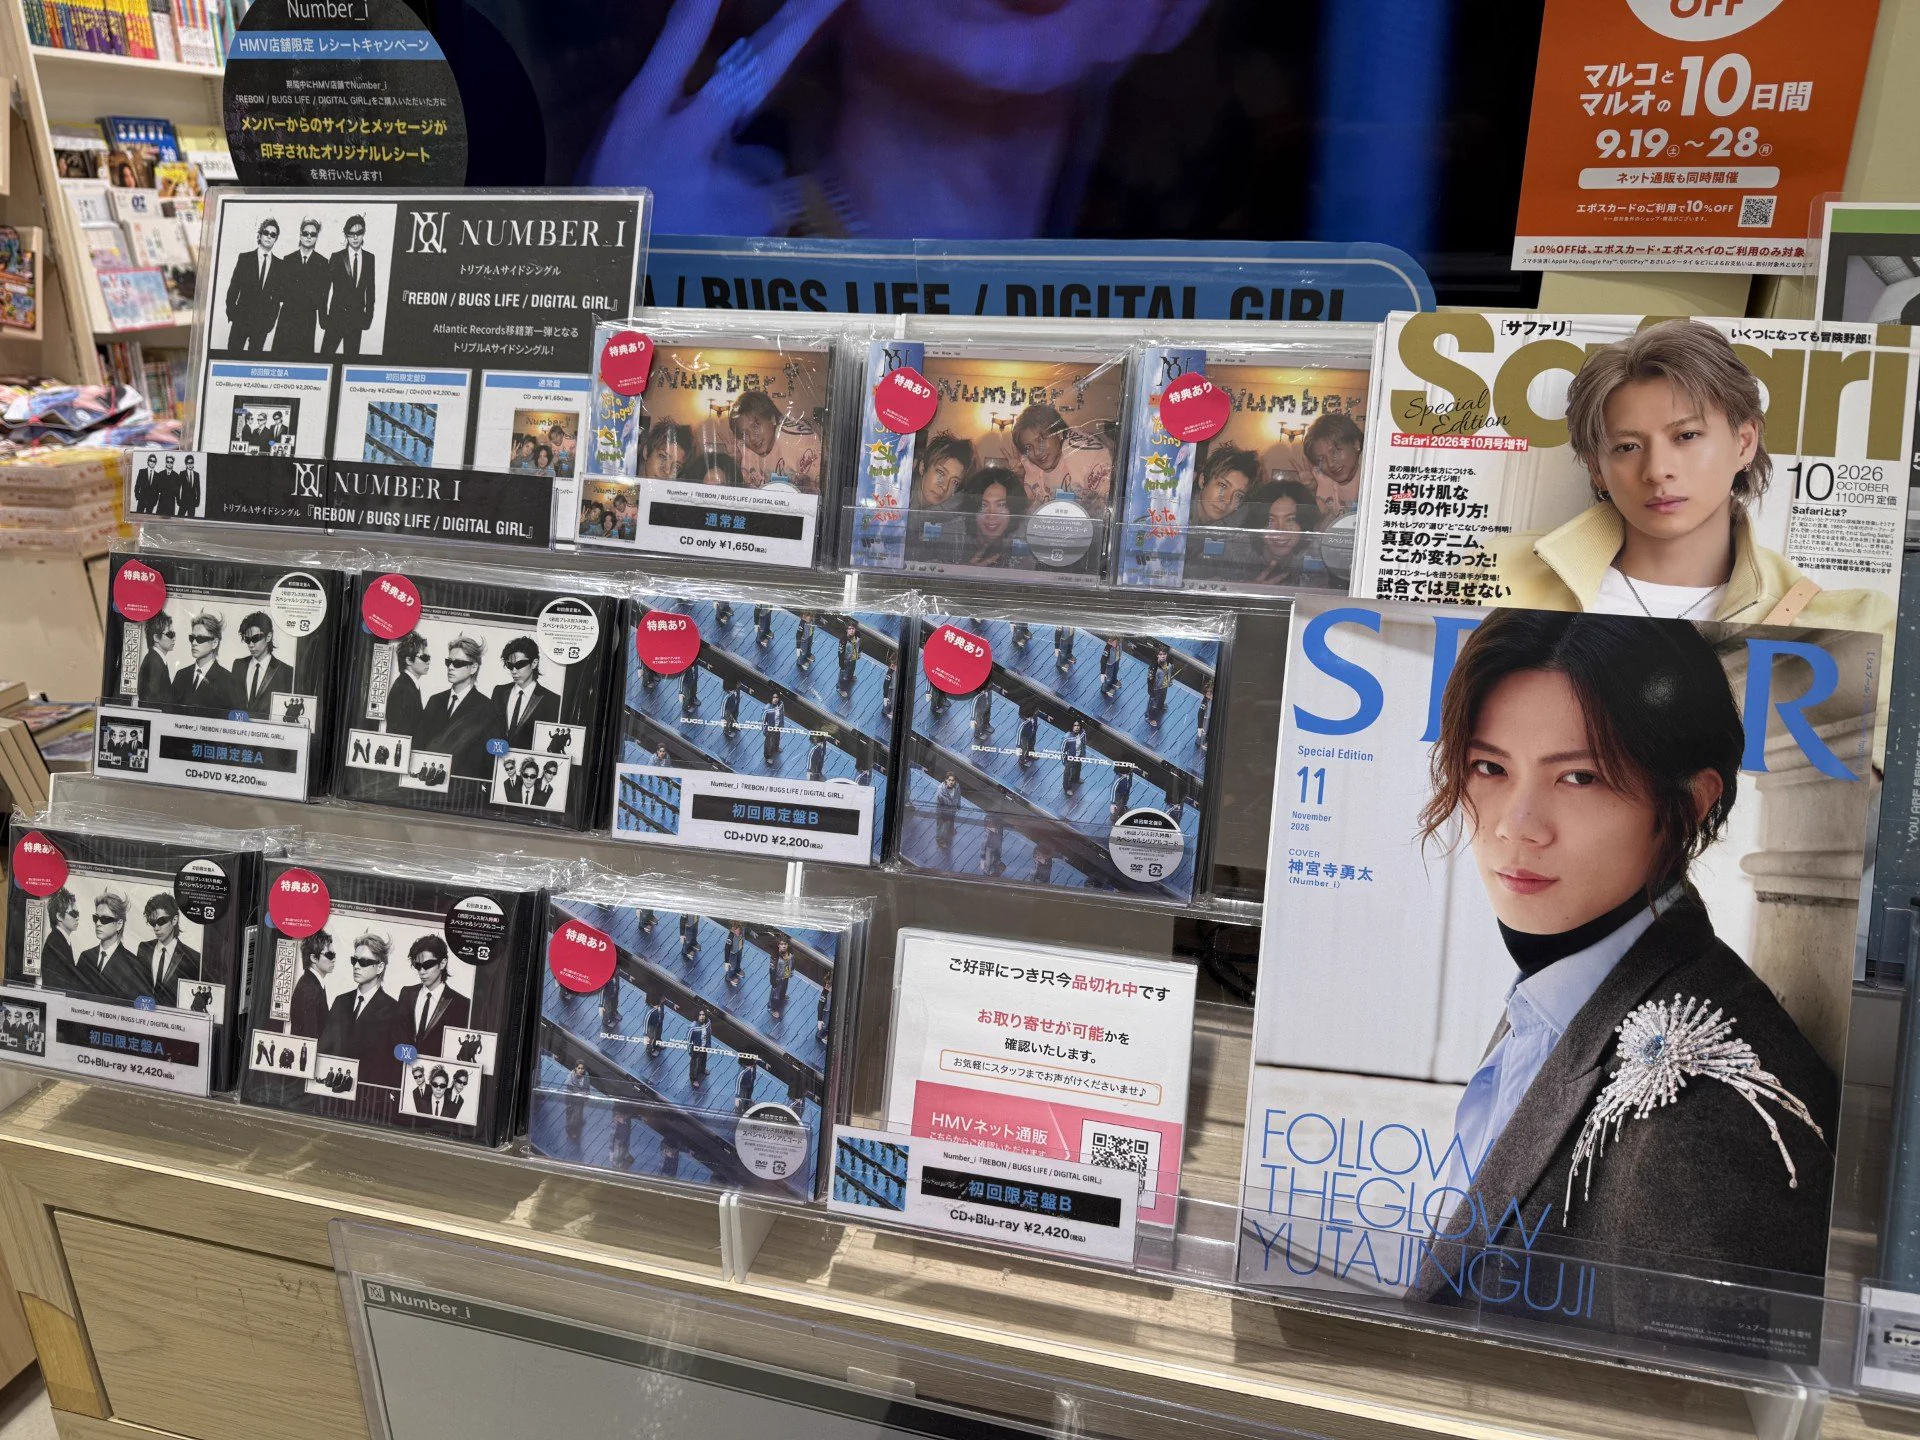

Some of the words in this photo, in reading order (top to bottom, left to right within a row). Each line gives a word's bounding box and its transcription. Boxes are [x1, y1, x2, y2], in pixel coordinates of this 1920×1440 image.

[287, 0, 369, 21] Number_i
[239, 38, 315, 53] HMV店舗限定
[319, 38, 429, 52] レシートキャンペーン
[1583, 62, 1675, 88] マルコと
[1578, 91, 1672, 117] マルオの
[241, 118, 448, 136] メンバーからのサインとメッセージが
[261, 144, 430, 163] 印字されたオリジナルレシート
[1616, 171, 1739, 185] ネット通販も同時開催
[460, 264, 561, 276] トリプルAサイドシングル
[458, 293, 491, 306] BUGS
[494, 294, 520, 308] LIFE
[531, 295, 578, 309] DIGITAL
[433, 323, 468, 335] Atlantic
[609, 340, 646, 357] 特典あり
[894, 373, 931, 399] 特典あり
[1168, 381, 1213, 405] 特典あり
[1390, 312, 1912, 462] Saari
[1404, 388, 1489, 426] Special
[1432, 411, 1511, 437] Edition
[1786, 461, 1835, 502] 10
[1837, 464, 1883, 481] 2026
[1386, 482, 1469, 500] 日灼け肌な
[1836, 481, 1889, 493] OCTOBER
[366, 511, 401, 528] BUGS
[404, 513, 430, 529] LIFE
[443, 516, 492, 534] DIGITAL
[705, 512, 747, 530] 通常盤
[679, 536, 694, 546] CD
[697, 537, 717, 549] only
[123, 569, 156, 583] 特典あり
[380, 580, 416, 607] 特典あり
[1376, 578, 1512, 599] 試合では見せない
[646, 619, 687, 632] 特典あり
[943, 629, 985, 659] 特典あり
[191, 743, 263, 765] 初回限定盤A
[1297, 745, 1335, 758] Special
[1338, 749, 1374, 762] Edition
[185, 768, 222, 782] CD+DVD
[1297, 766, 1326, 805] 11
[769, 786, 786, 794] BUGS
[786, 787, 799, 795] LIFE
[804, 789, 826, 799] DIGITAL
[731, 803, 819, 825] 初回限定盤B
[1291, 811, 1332, 823] November
[724, 830, 768, 843] CD+DVD
[1290, 822, 1310, 832] 2026
[23, 841, 56, 856] 特典あり
[1288, 848, 1321, 859] COVER
[1288, 859, 1373, 882] 神宮寺勇太
[280, 879, 320, 894] 特典あり
[565, 928, 607, 952] 特典あり
[949, 957, 1171, 1002] ご好評につき只今品切れ中です
[120, 1015, 135, 1024] BUGS
[135, 1017, 147, 1026] LIFE
[150, 1020, 170, 1030] DIGITAL
[977, 1008, 1131, 1045] お取り寄せが可能かを
[89, 1029, 164, 1055] 初回限定盤A
[1004, 1037, 1098, 1065] 確認いたします。
[77, 1054, 128, 1073] CD+Blu-ray
[931, 1111, 1049, 1146] HMVネット通販
[1262, 1108, 1496, 1185] FOLLOW
[943, 1151, 976, 1164] Number_i
[1012, 1163, 1032, 1173] BUGS
[1033, 1165, 1048, 1175] LIFE
[1054, 1169, 1081, 1182] DIGITAL
[968, 1179, 1072, 1212] 初回限定盤B
[950, 1209, 1020, 1232] CD+Blu-ray
[389, 1290, 471, 1319] Number_i
